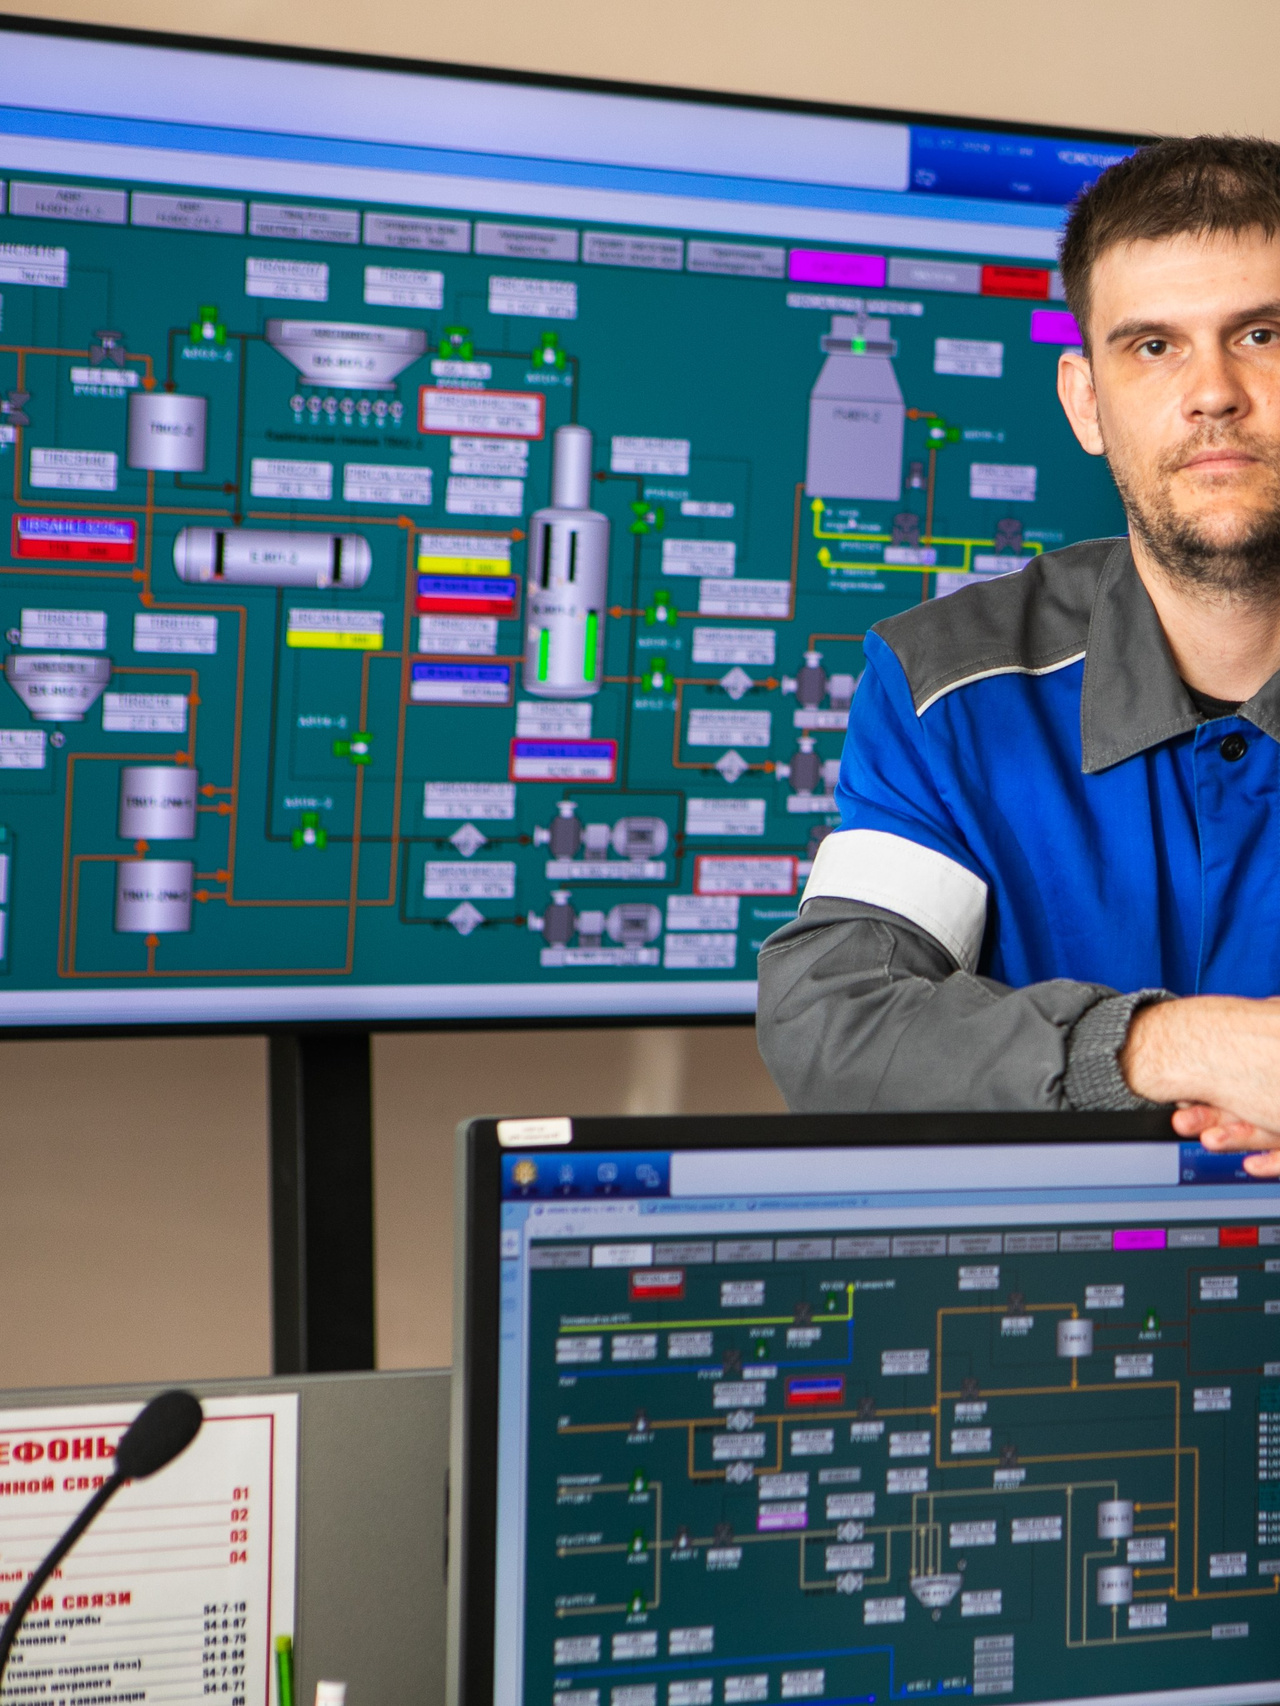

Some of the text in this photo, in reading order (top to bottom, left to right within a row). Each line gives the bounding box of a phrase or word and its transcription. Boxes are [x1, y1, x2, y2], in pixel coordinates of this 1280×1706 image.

[232, 1487, 249, 1501] 01
[231, 1508, 248, 1522] 02
[230, 1529, 248, 1543] 03
[229, 1550, 247, 1564] 04
[62, 1591, 132, 1611] СВЯЗИ
